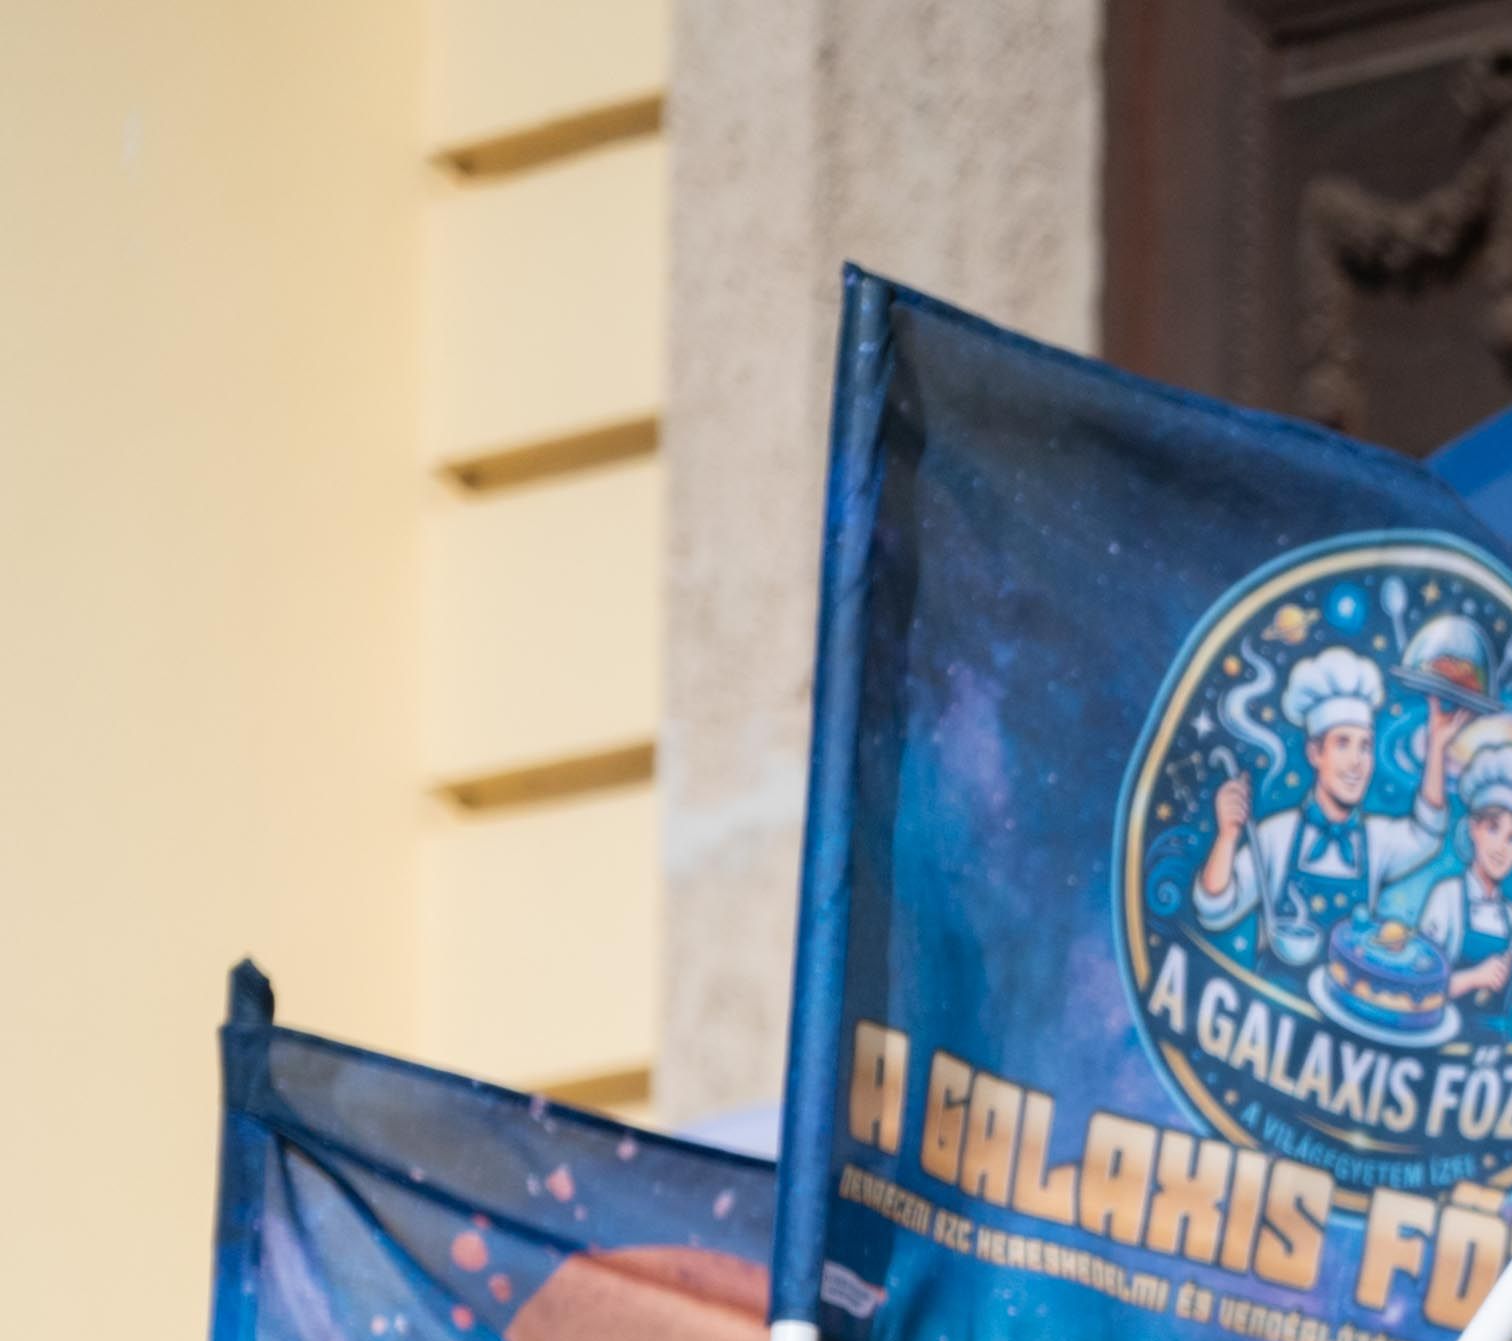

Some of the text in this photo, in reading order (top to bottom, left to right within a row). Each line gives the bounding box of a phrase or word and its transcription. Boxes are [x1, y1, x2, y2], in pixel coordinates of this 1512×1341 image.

[1148, 944, 1189, 1033] A
[1197, 976, 1424, 1133] GALAXIS
[848, 1019, 910, 1156] A
[921, 1049, 1335, 1292] GALAXIS
[933, 1209, 972, 1253] SZC
[1174, 1280, 1213, 1324] ÉS
